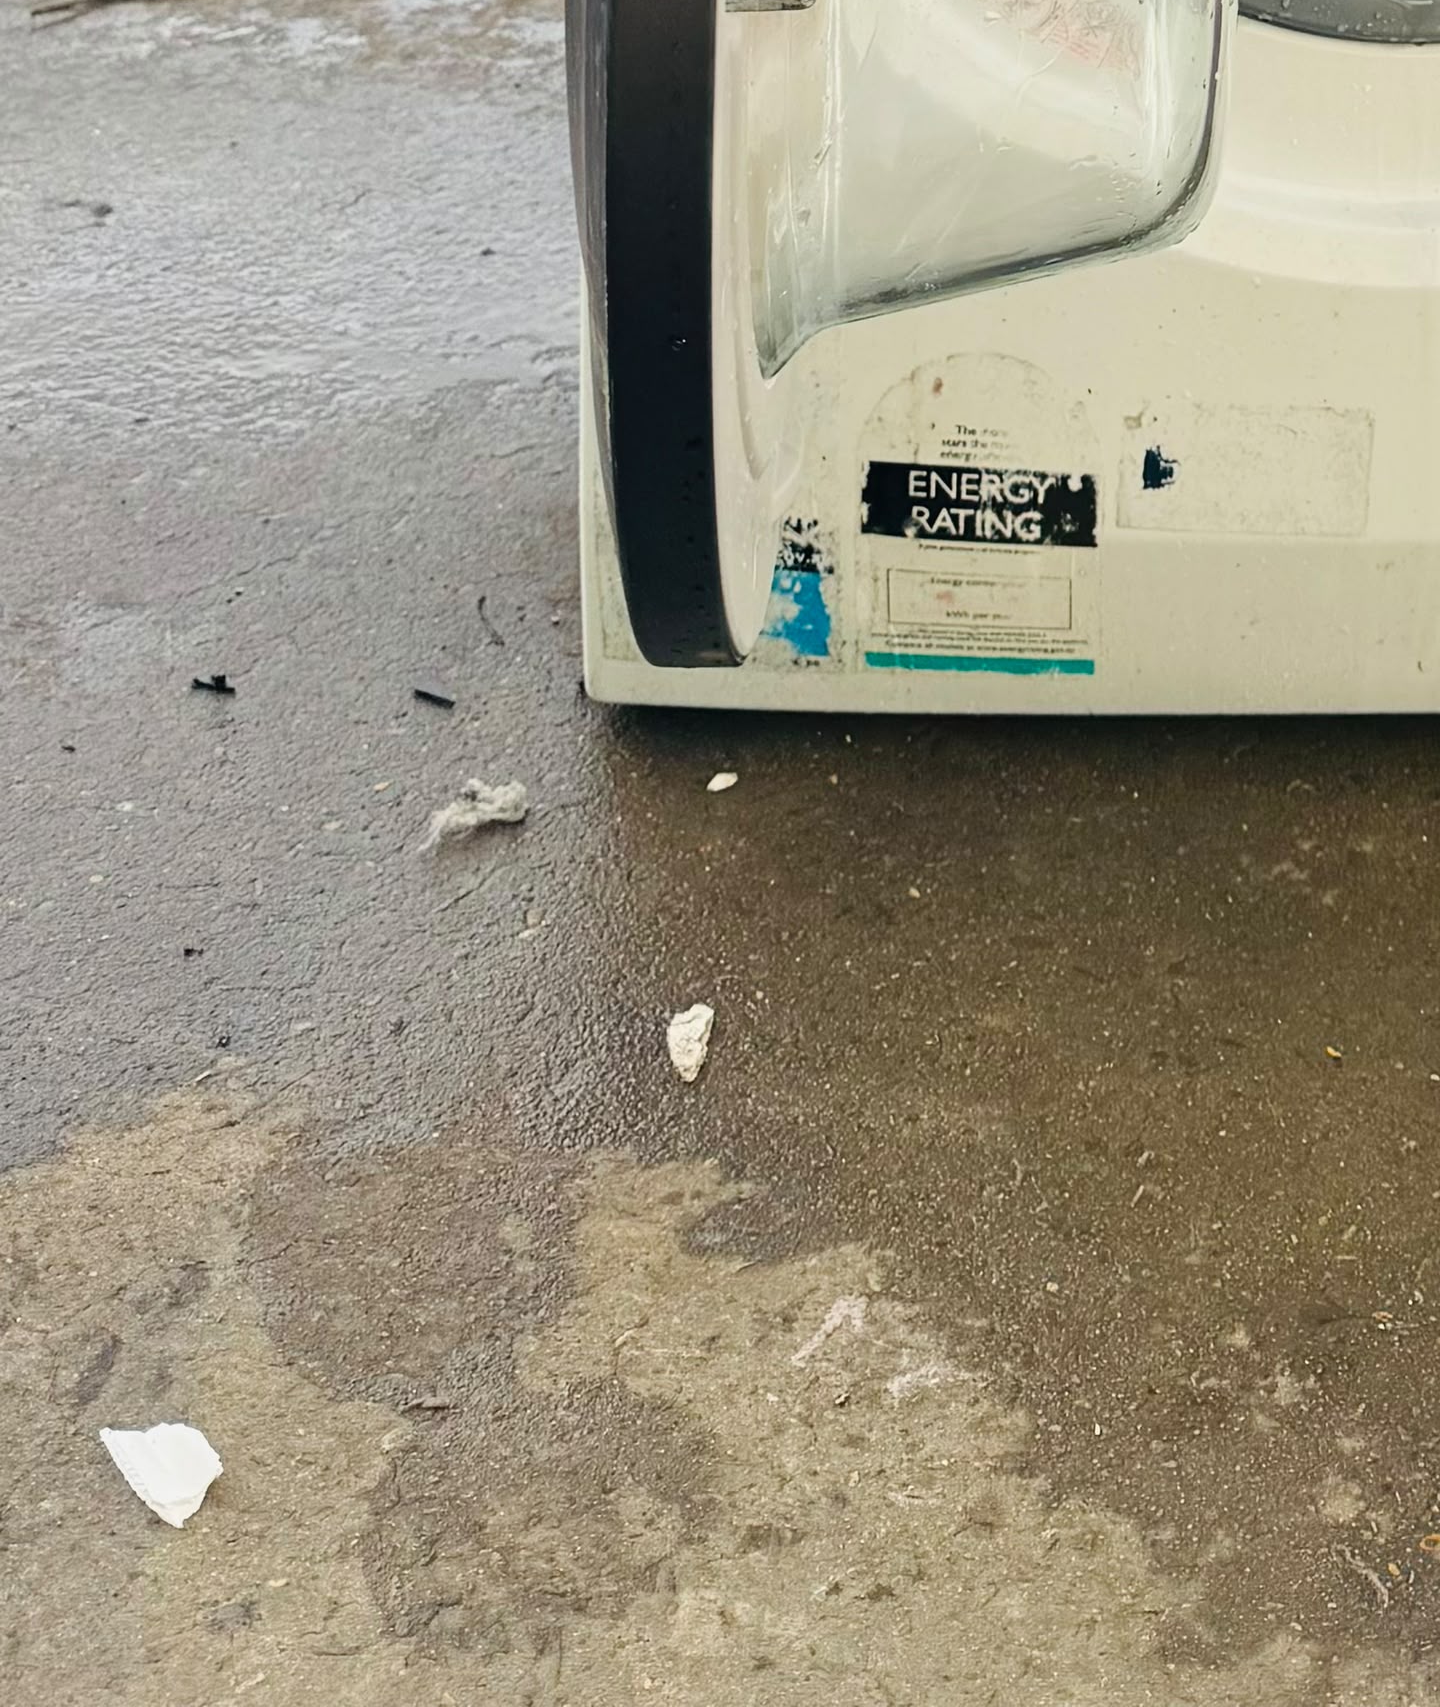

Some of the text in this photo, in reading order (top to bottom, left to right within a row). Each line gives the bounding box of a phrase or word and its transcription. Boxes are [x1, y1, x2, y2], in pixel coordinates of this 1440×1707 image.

[956, 425, 977, 436] The
[908, 470, 1055, 505] ENERGY
[908, 505, 1045, 541] RATING
